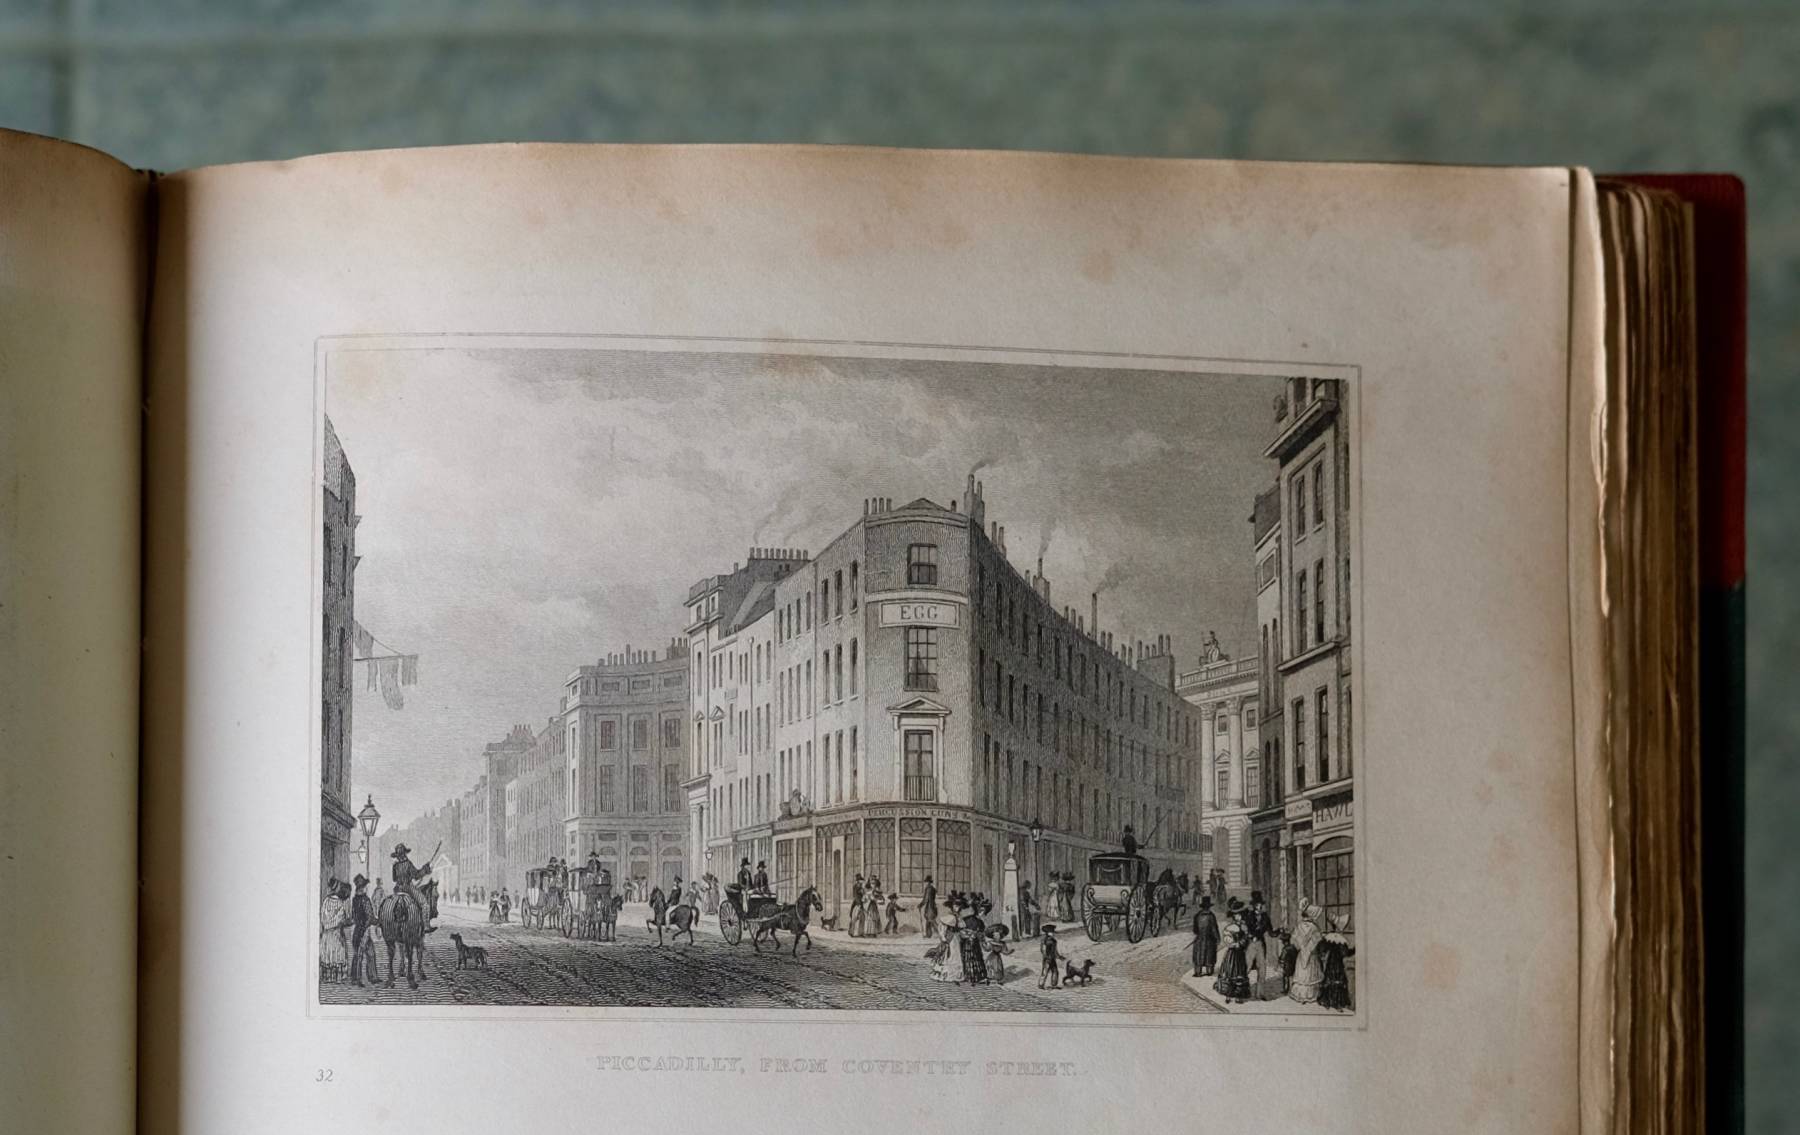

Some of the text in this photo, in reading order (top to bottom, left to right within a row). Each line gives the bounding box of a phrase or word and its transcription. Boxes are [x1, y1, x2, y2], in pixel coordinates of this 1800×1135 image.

[900, 604, 938, 620] EGG
[596, 1055, 746, 1074] PICCADILLY,
[759, 1057, 828, 1073] FROM
[842, 1059, 972, 1075] COVENTRY
[315, 1068, 334, 1082] 32
